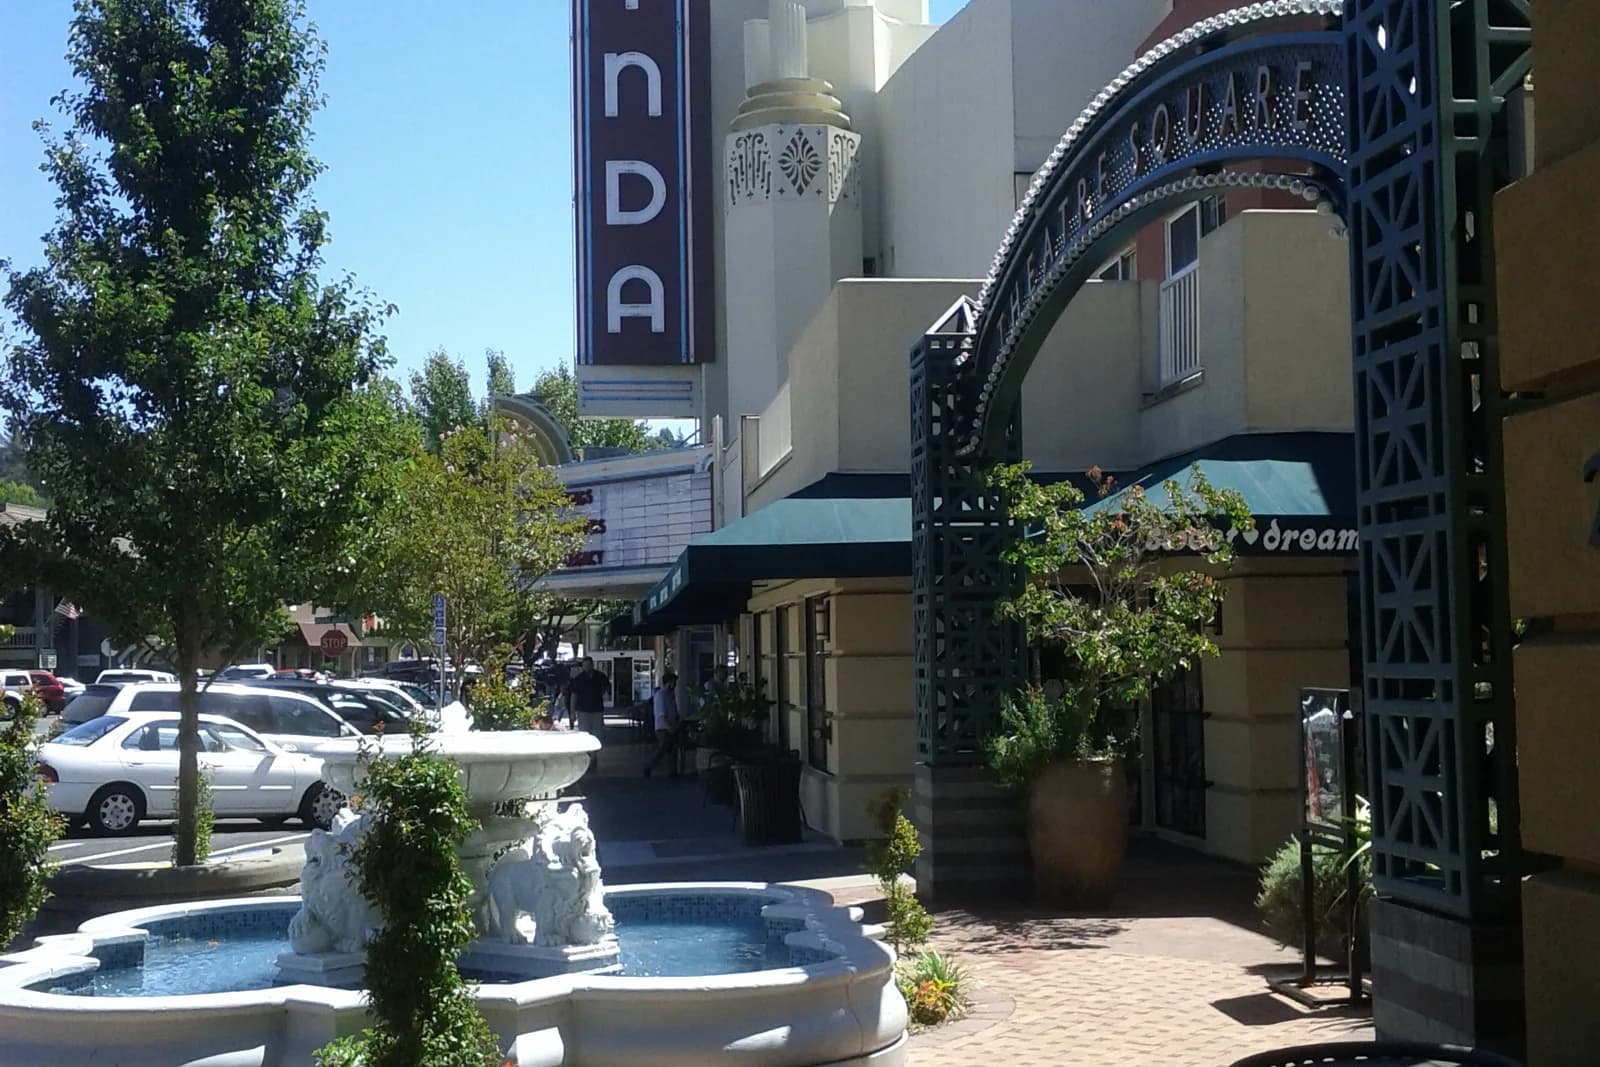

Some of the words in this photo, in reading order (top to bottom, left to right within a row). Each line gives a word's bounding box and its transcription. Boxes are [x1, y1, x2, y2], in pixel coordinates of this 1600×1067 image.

[998, 153, 1109, 345] THEATRE
[1130, 61, 1312, 174] SQUARE
[322, 638, 346, 649] STOP
